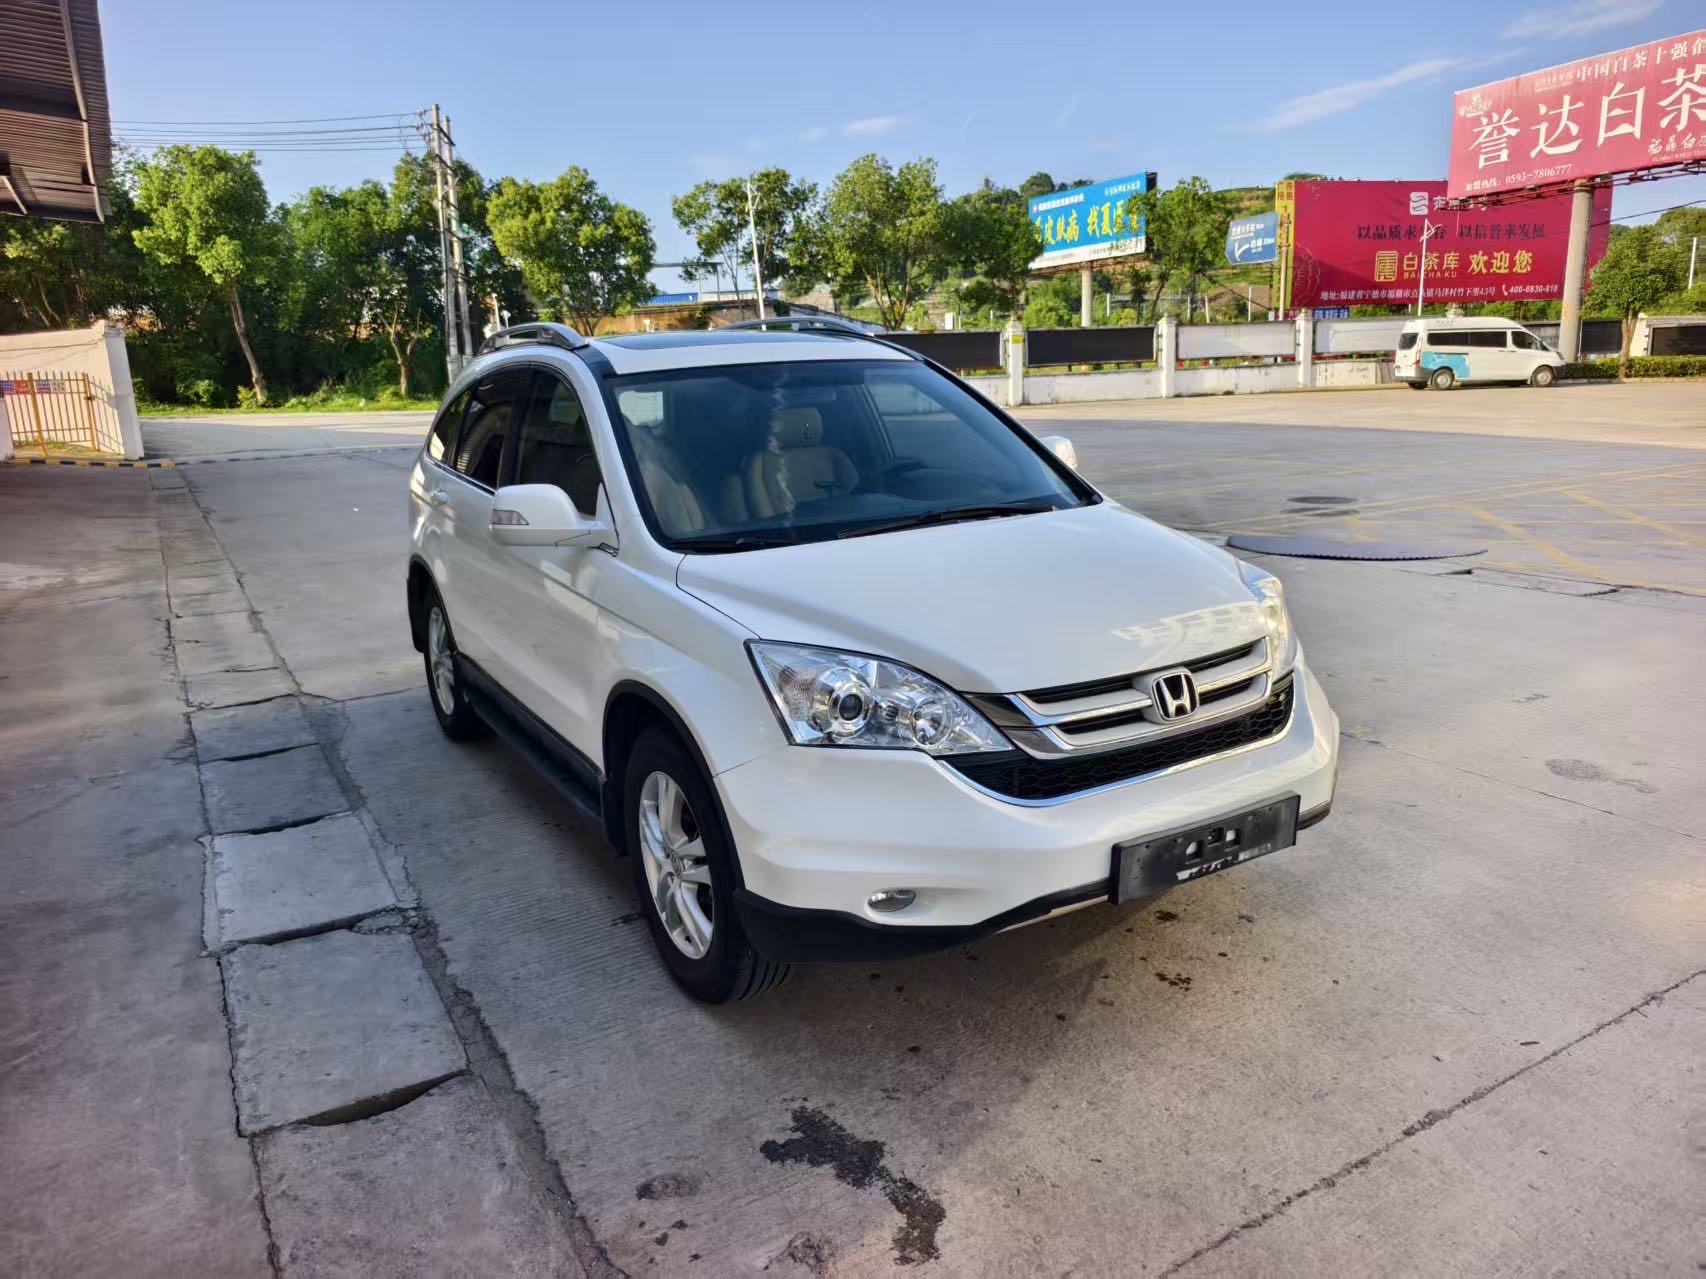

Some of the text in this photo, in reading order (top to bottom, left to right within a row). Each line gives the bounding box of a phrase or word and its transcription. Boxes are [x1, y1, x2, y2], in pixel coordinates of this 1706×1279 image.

[1467, 63, 1706, 169] 誉达白茶
[1505, 163, 1574, 184] 0593-7806777
[1403, 251, 1460, 271] 白茶库
[1467, 249, 1533, 274] 欢迎您
